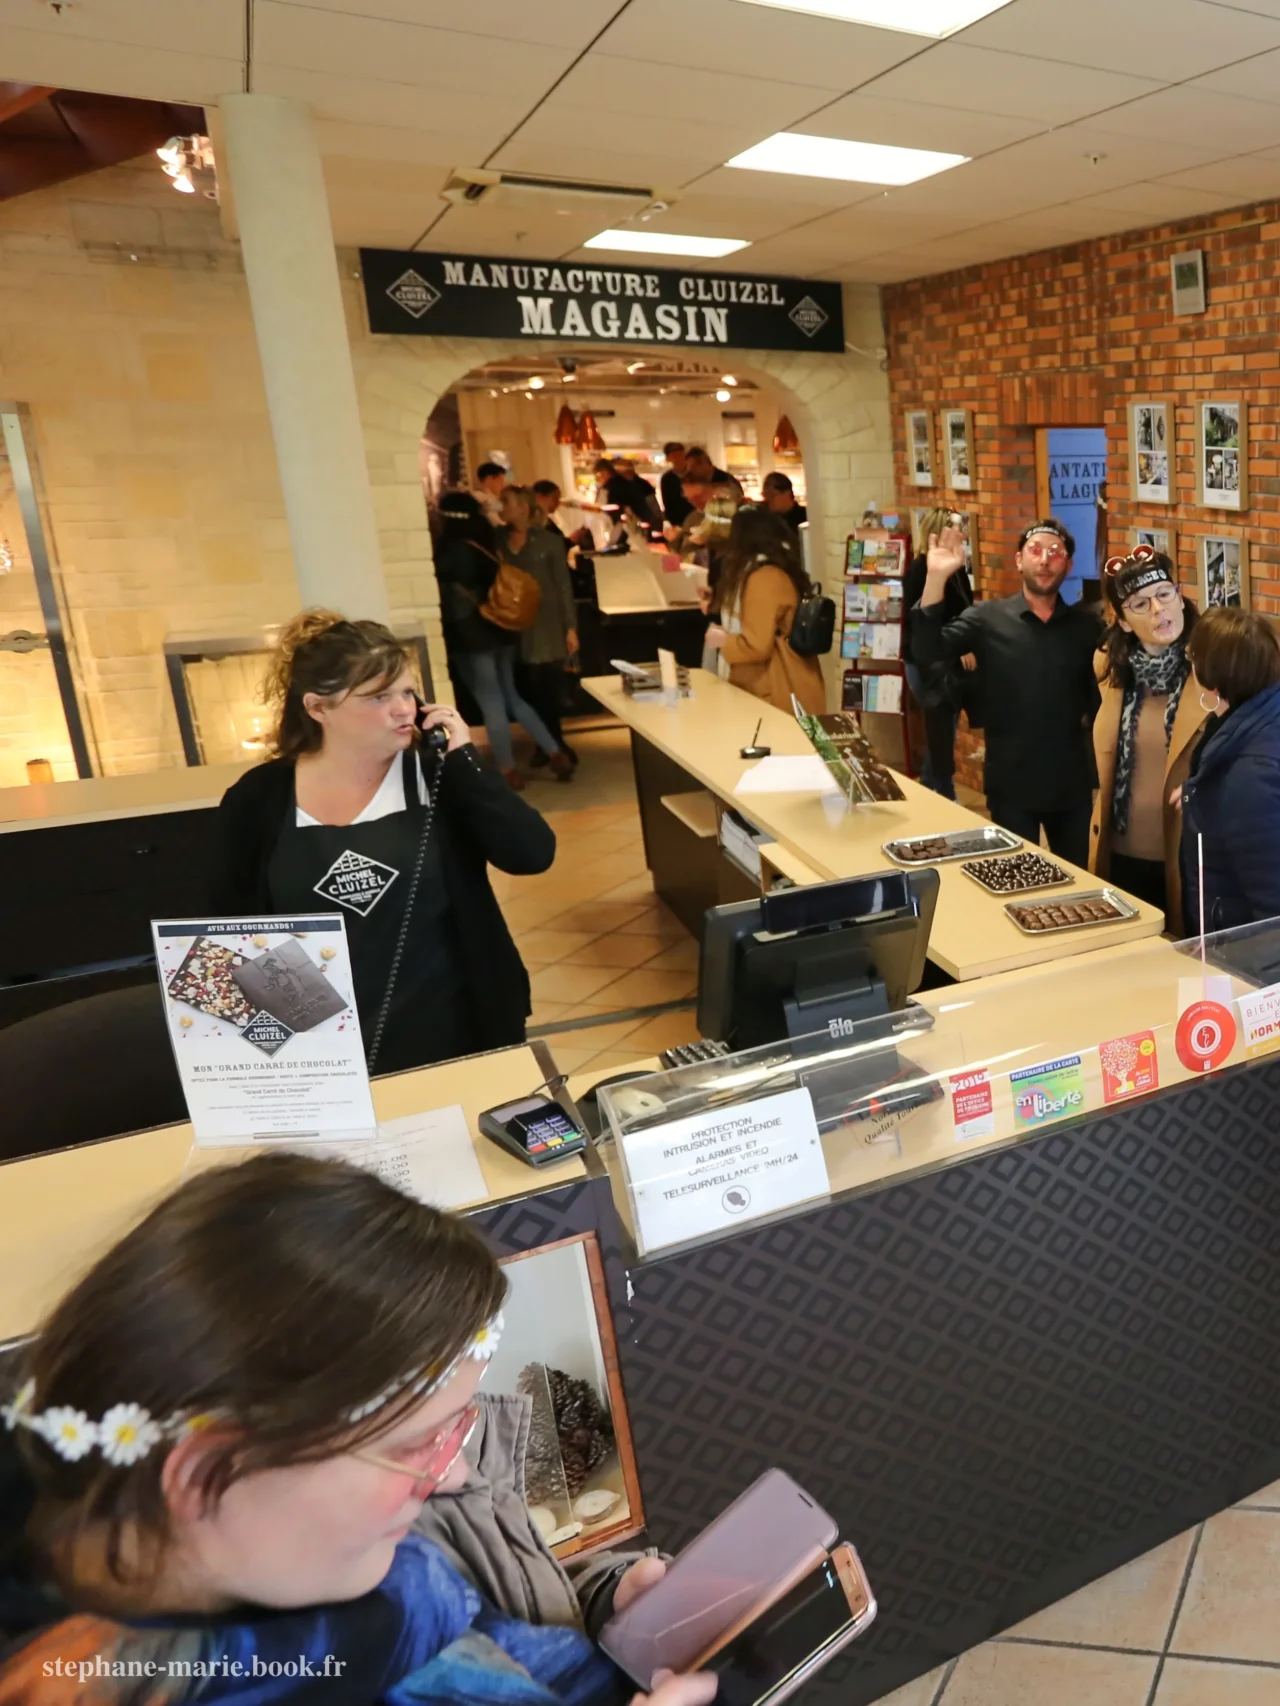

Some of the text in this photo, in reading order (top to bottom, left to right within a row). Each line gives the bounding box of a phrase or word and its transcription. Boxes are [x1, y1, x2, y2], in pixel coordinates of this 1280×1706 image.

[442, 260, 785, 305] MANUFACTURE CLUIZEL
[517, 296, 729, 343] MAGASIN
[328, 874, 386, 895] CLUIZEL
[335, 868, 376, 884] MICHEL
[242, 923, 290, 931] GOURMANDS
[248, 1032, 287, 1041] CLUIZEL
[193, 1065, 213, 1073] MON
[253, 1061, 285, 1070] CARRÉ
[287, 1061, 299, 1069] DE
[1011, 1066, 1045, 1080] PARTENAIRE
[1061, 1057, 1079, 1067] CARTE
[955, 1073, 985, 1091] 2019
[1016, 1090, 1082, 1118] en liberté
[663, 1117, 782, 1159] INTRUSION ET INCENDIE
[691, 1117, 753, 1141] PROTECTION
[864, 1120, 895, 1144] Qualité
[695, 1140, 758, 1165] ALARMES ET
[740, 1146, 769, 1161] VIDEO
[662, 1164, 760, 1200] TELESURVEILLANCE
